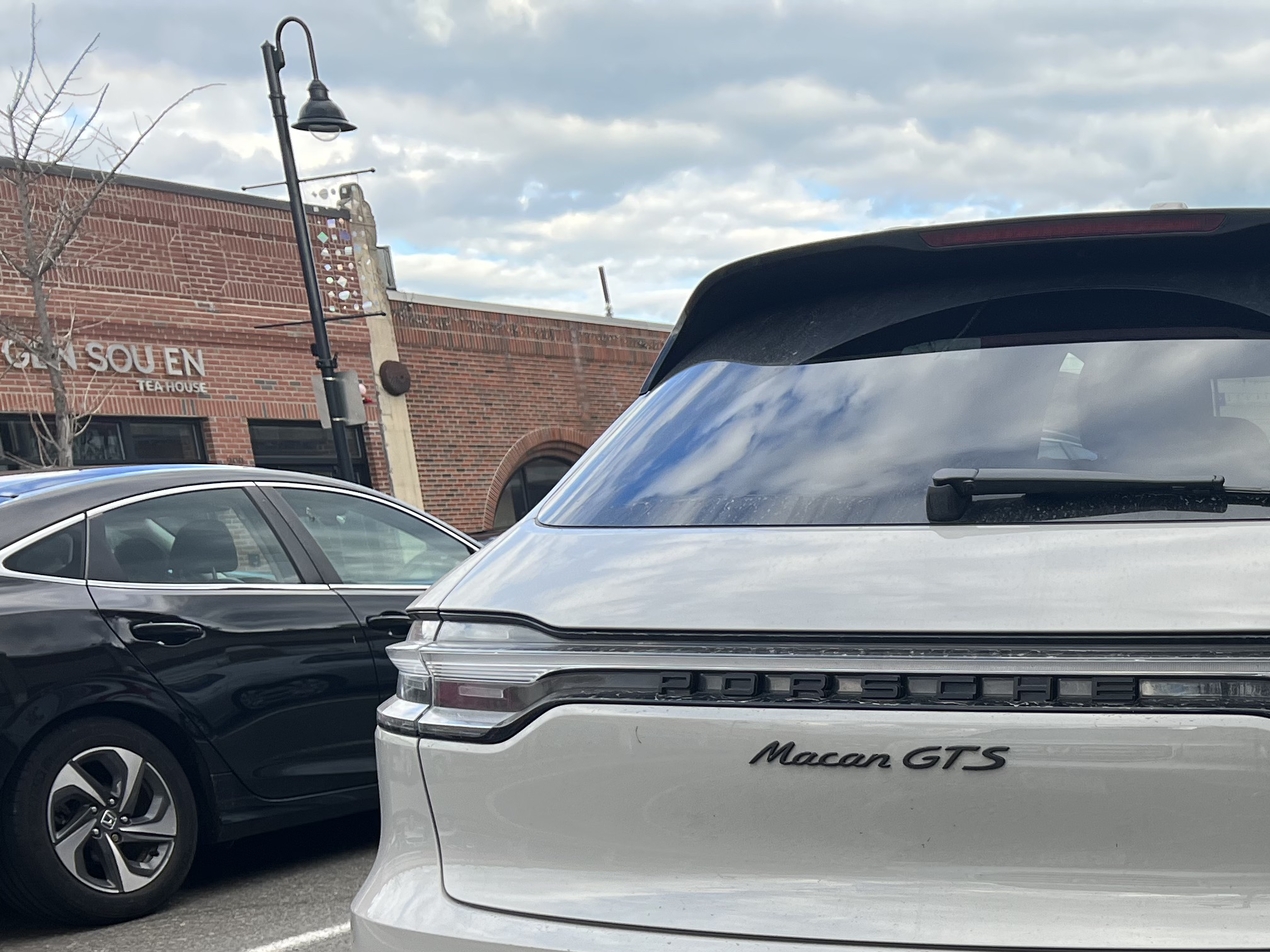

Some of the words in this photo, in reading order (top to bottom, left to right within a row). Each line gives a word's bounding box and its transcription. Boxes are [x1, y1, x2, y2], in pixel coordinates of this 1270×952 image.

[85, 341, 155, 374] SOU
[163, 347, 206, 377] EN
[136, 379, 163, 392] TEA
[165, 380, 209, 394] HOUSE
[658, 671, 1139, 700] PORSCHE
[749, 740, 891, 768] Macan
[902, 746, 1011, 771] GTS
